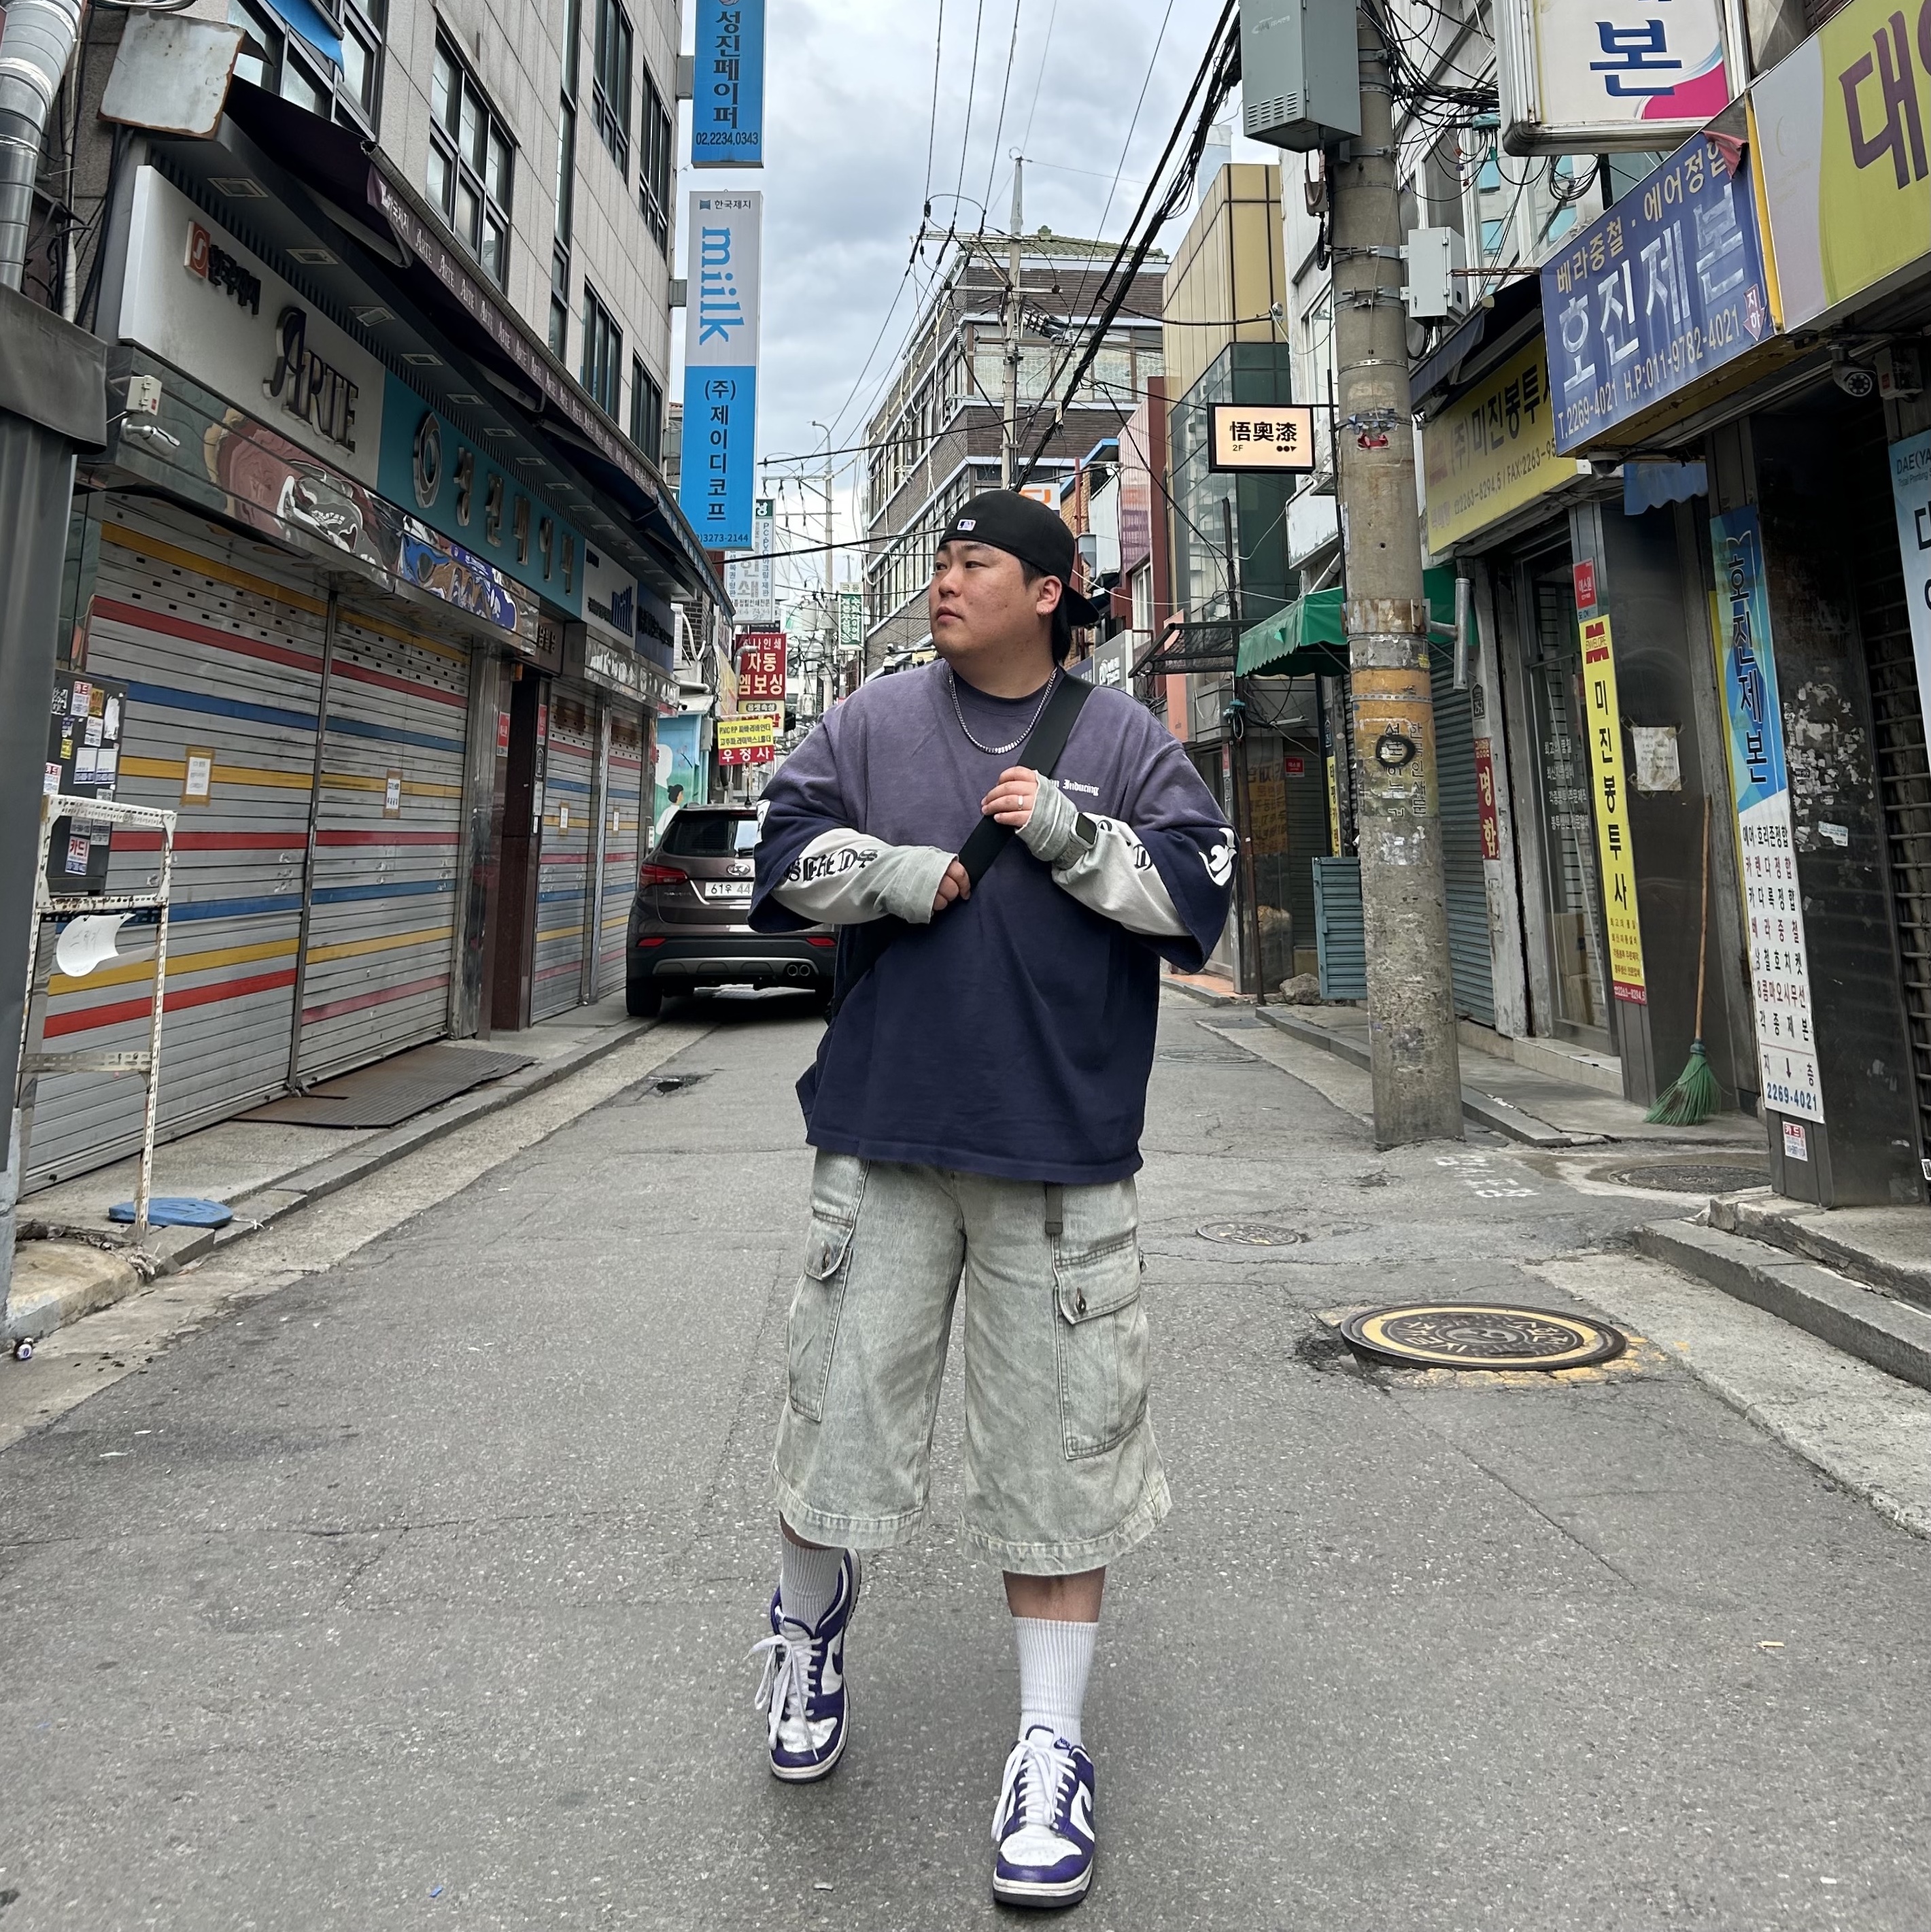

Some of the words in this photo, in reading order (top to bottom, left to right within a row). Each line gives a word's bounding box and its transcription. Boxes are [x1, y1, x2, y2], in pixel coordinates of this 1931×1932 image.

[713, 11, 741, 129] 성진페이퍼
[1590, 20, 1682, 97] 본
[1838, 10, 1931, 190] 대
[715, 199, 751, 210] 한국제지
[415, 228, 432, 264] ARTE
[439, 254, 455, 288] ARTE
[1556, 216, 1626, 294] 베라중철
[699, 226, 745, 345] milk
[1558, 182, 1745, 393] 호진제본
[1745, 288, 1761, 331] 지하
[262, 306, 360, 454] ARTE
[1558, 378, 1619, 439] T.2269-4021
[1624, 304, 1740, 402] H.P:011-9782-4021
[1231, 421, 1297, 442] 悟奧漆
[1450, 356, 1551, 477] (주)미진봉투
[1507, 438, 1556, 484] FAX:2263-95
[748, 652, 776, 673] 자동
[1586, 636, 1607, 651] ENVELOPE
[739, 673, 783, 695] 엠보싱
[1726, 554, 1767, 785] 호진제본
[721, 746, 770, 762] 우정사
[1062, 779, 1099, 796] Inducing
[1594, 680, 1627, 911] 미진봉투사
[711, 885, 732, 894] 61우
[737, 885, 751, 894] 44
[1749, 886, 1795, 911] 카다록정합
[1751, 917, 1799, 944] 베라중철
[1760, 1009, 1809, 1042] 각종제본
[1767, 1081, 1817, 1112] 2269-4021
